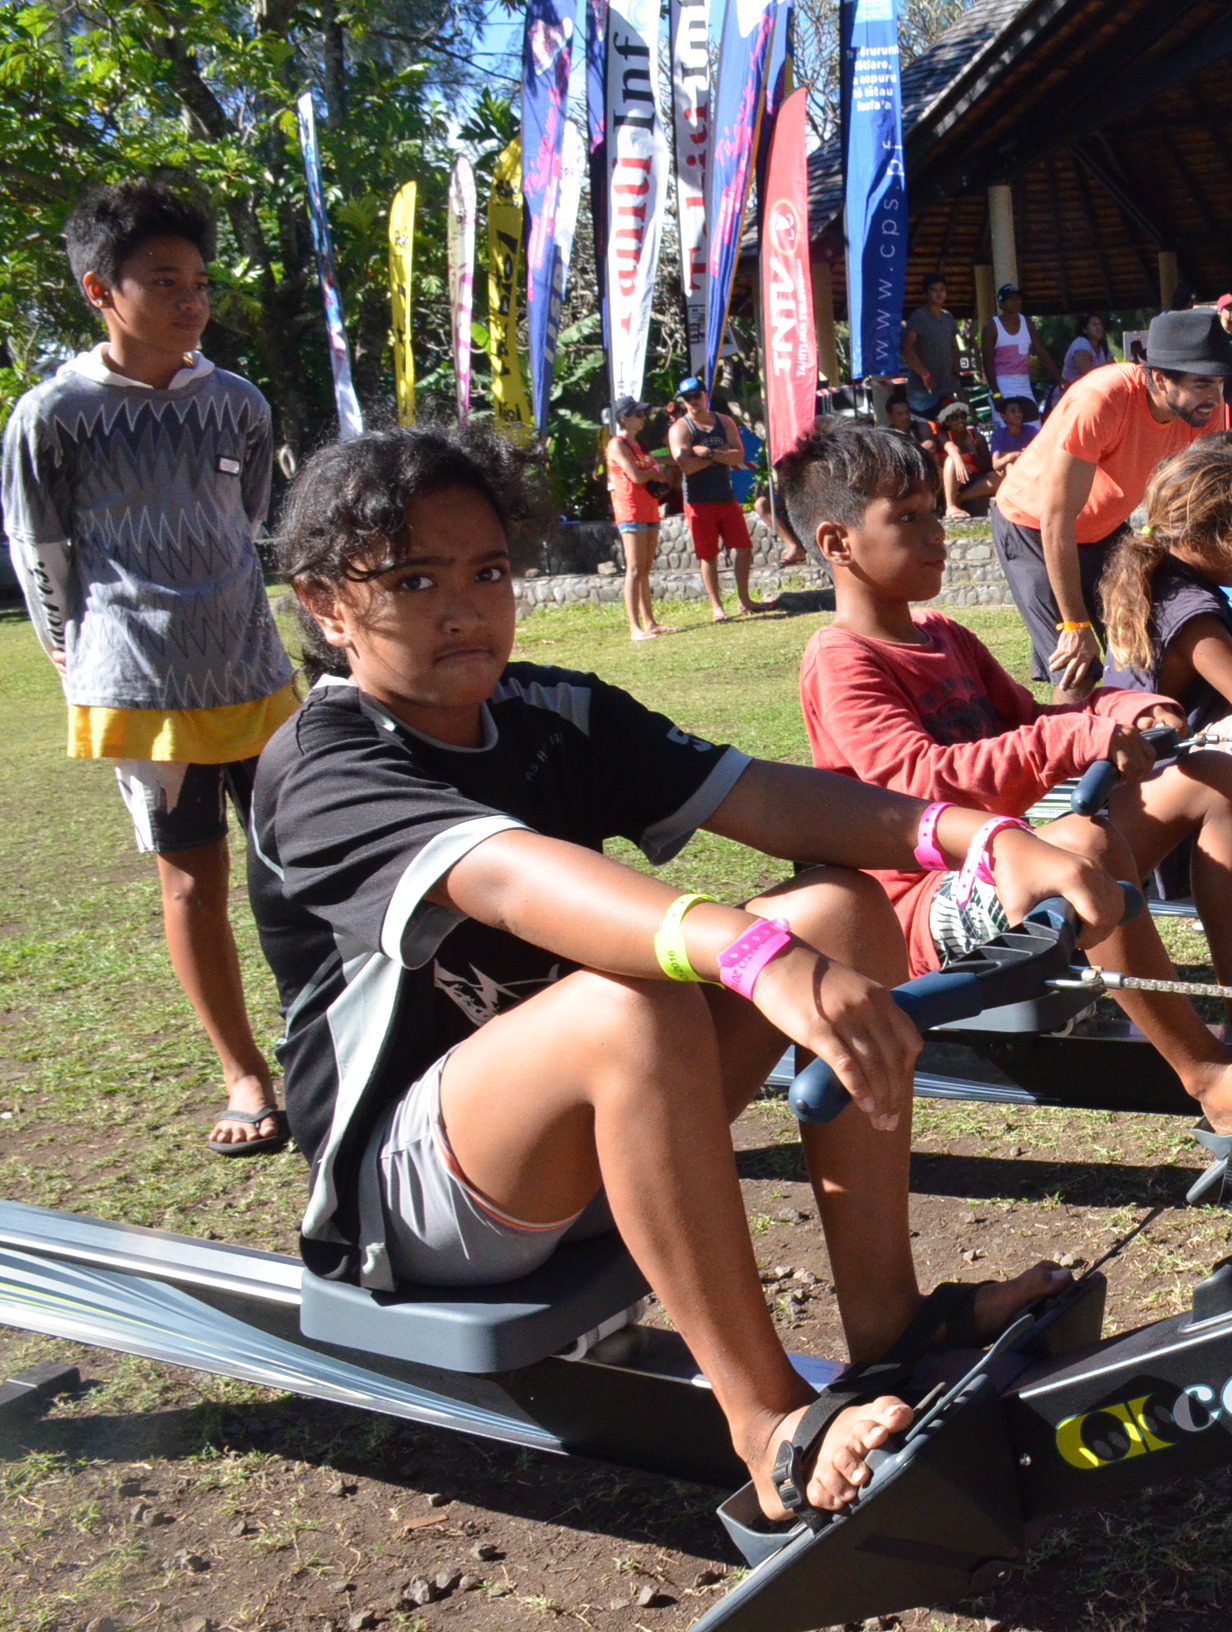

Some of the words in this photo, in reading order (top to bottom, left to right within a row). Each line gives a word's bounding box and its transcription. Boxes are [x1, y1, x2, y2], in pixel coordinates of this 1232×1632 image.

[876, 140, 905, 361] www.cps.pf
[769, 257, 796, 377] TNTV
[796, 344, 808, 377] TAHITI
